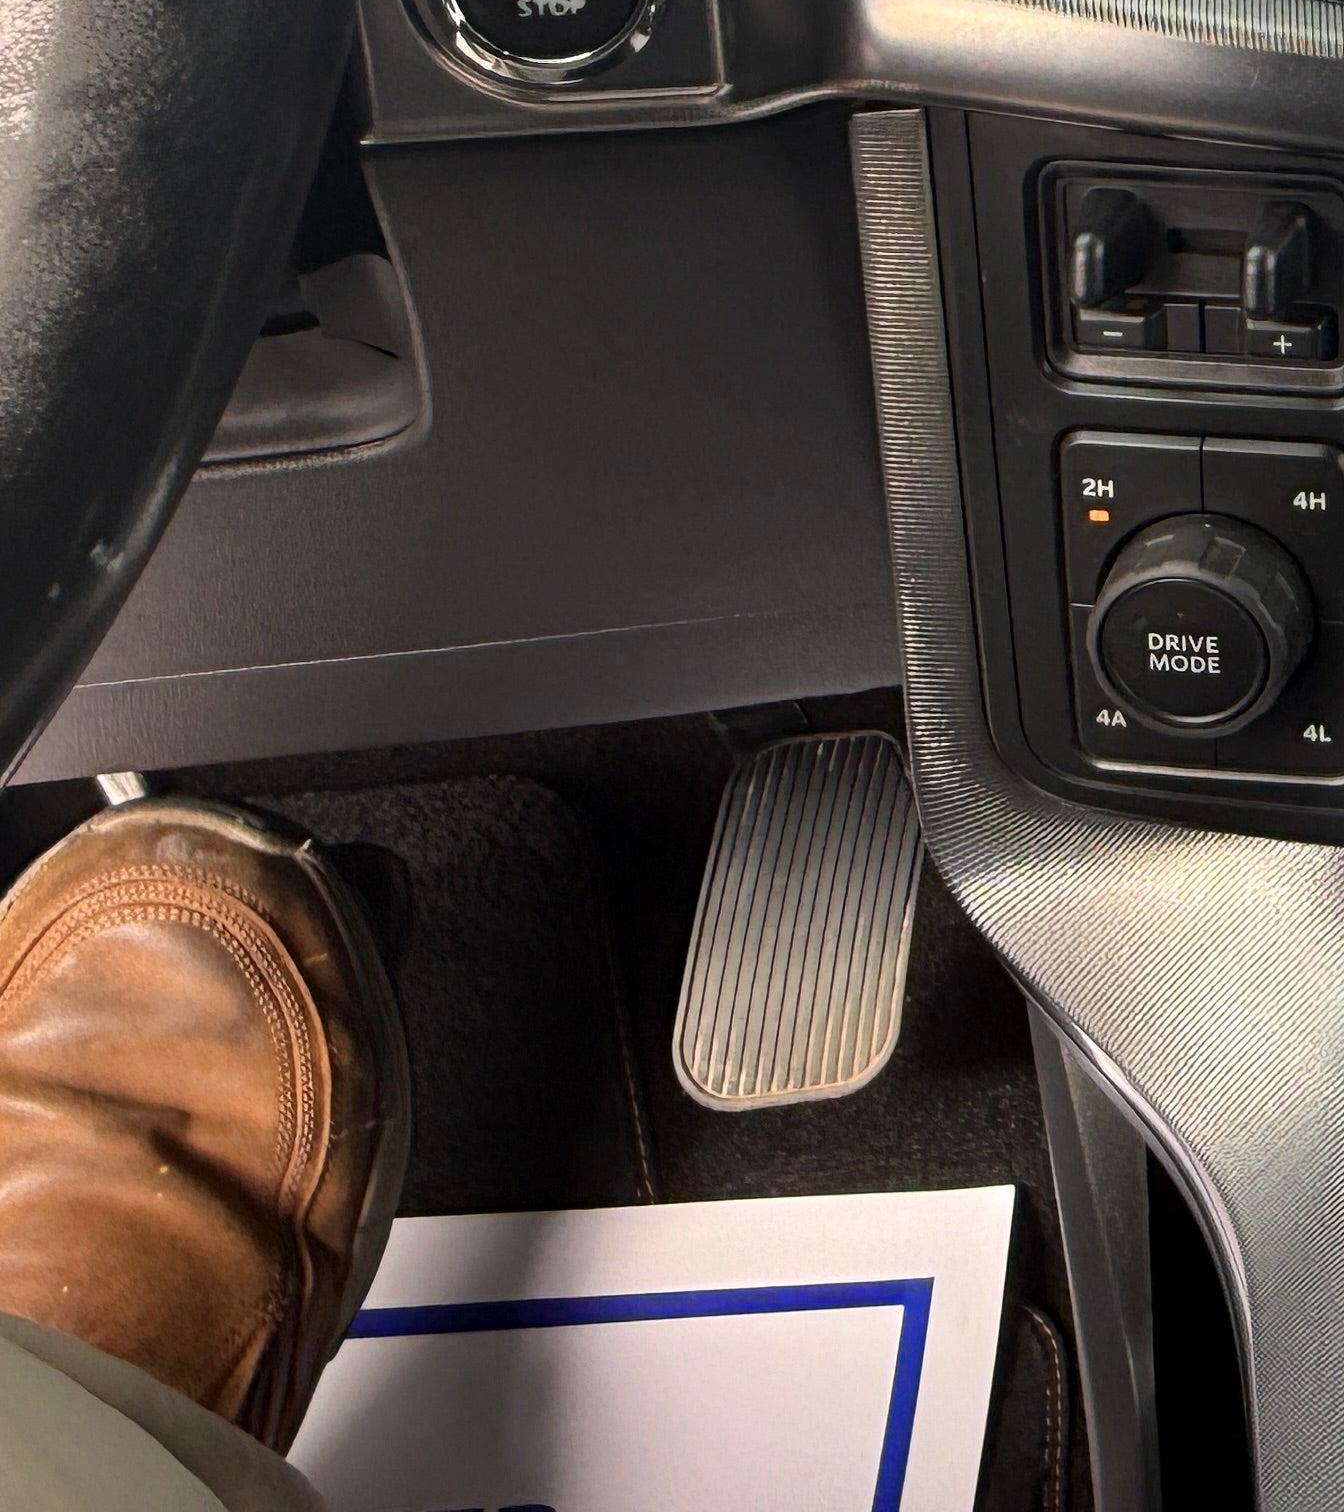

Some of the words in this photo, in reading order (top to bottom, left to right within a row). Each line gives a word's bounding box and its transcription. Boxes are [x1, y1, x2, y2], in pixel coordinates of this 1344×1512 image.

[1081, 478, 1115, 499] 2H
[1292, 491, 1327, 511] 4H
[1147, 632, 1219, 654] DRIVE
[1149, 653, 1221, 674] MODE
[1096, 709, 1127, 728] 4A
[1303, 724, 1332, 743] 4L
